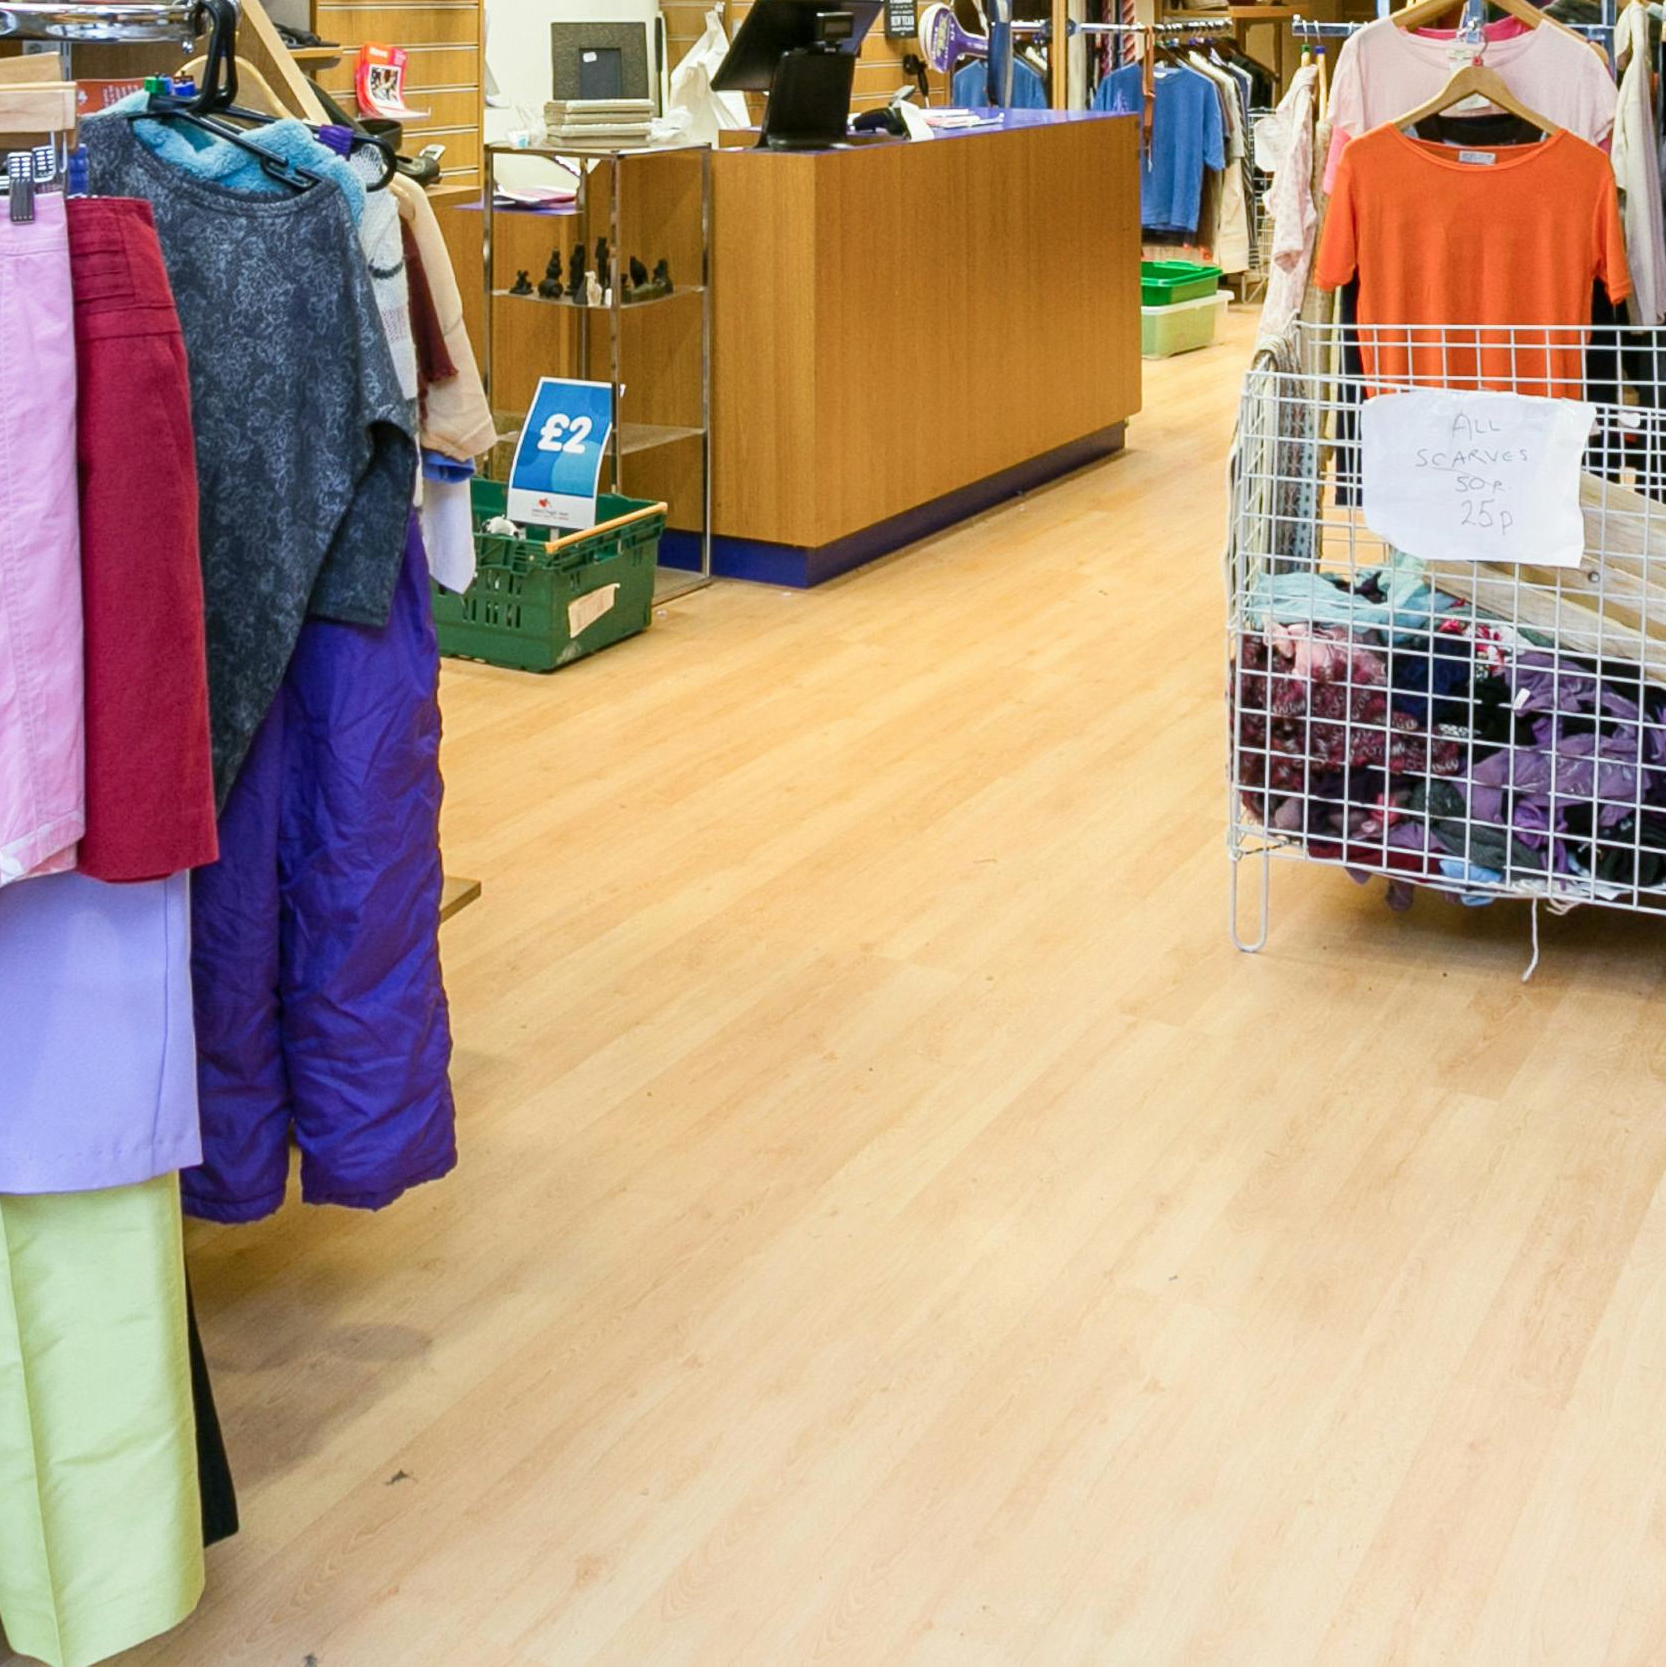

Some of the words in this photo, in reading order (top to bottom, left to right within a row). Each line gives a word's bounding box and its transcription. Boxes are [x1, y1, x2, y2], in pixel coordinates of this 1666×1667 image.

[537, 413, 593, 455] £2
[1451, 411, 1502, 441] ALL
[1415, 448, 1528, 468] SCARVES
[1460, 499, 1514, 536] 25p
